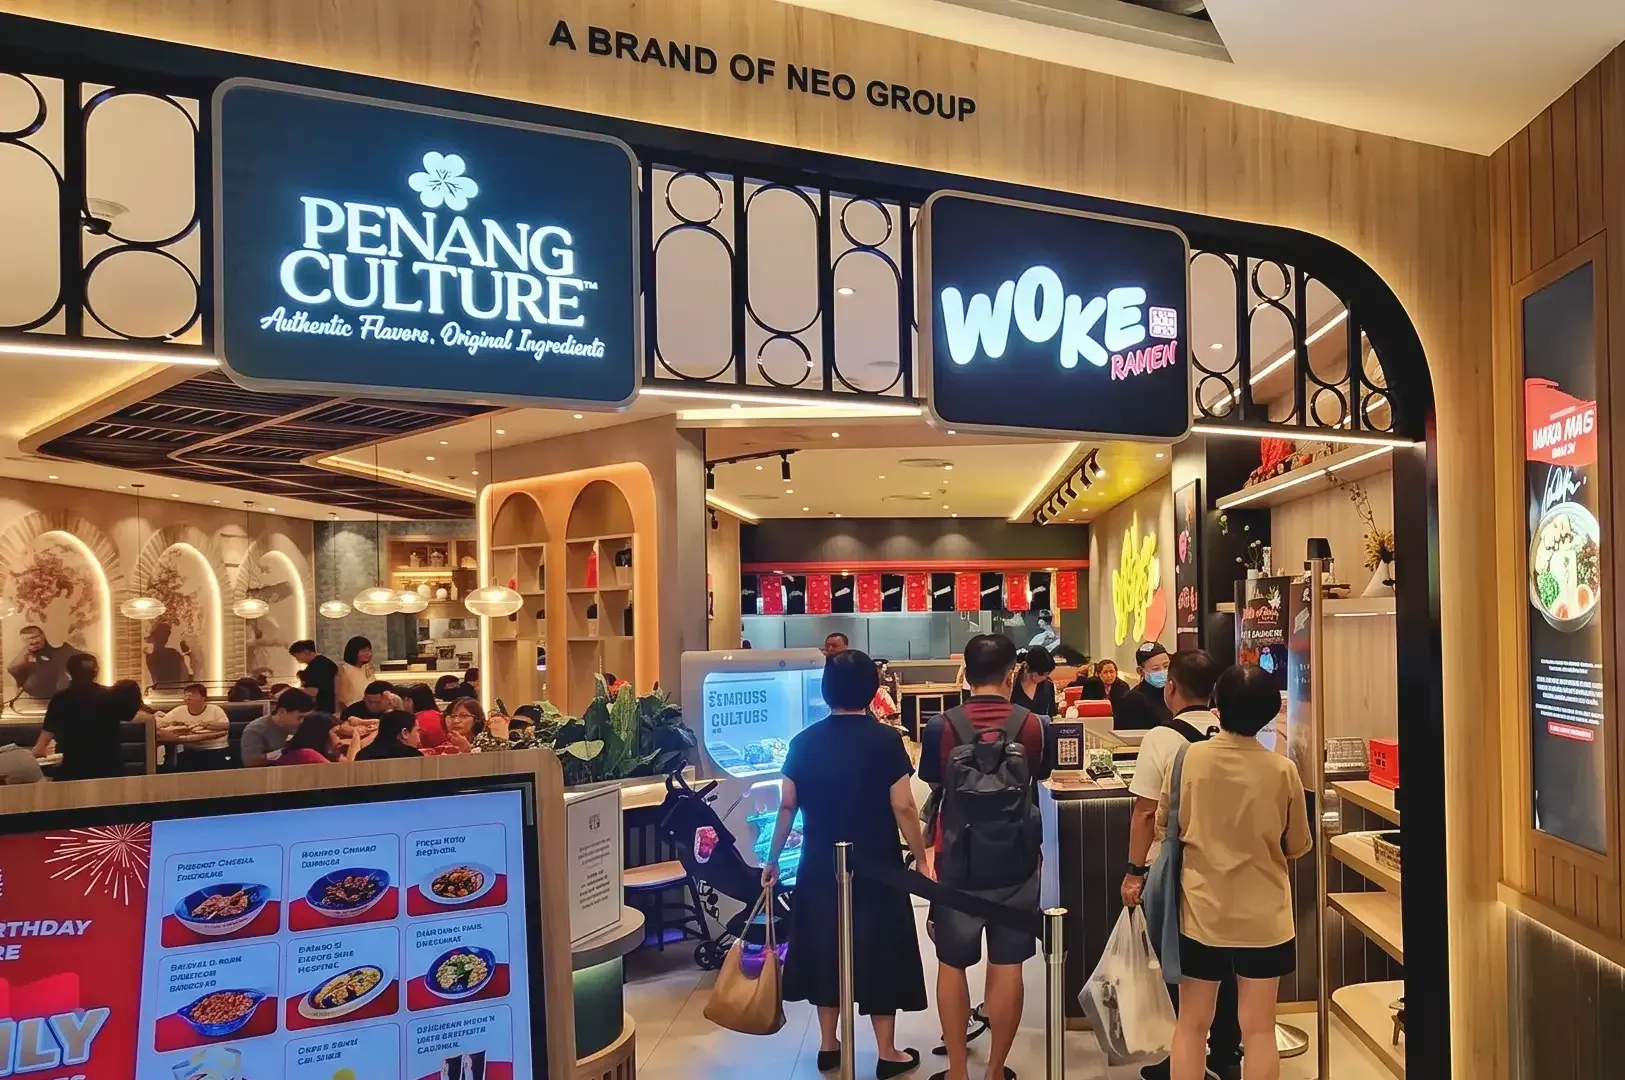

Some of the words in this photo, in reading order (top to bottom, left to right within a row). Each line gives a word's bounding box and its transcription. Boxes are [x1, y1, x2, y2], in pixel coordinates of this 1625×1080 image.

[549, 20, 576, 50] A
[588, 26, 717, 75] BRAND
[729, 54, 776, 85] OF
[787, 64, 856, 98] NEO
[866, 80, 976, 122] GROUP
[299, 196, 575, 276] PENANG
[260, 306, 353, 337] Authentic
[359, 315, 435, 345] Flavors.
[440, 321, 514, 355] Original
[941, 265, 1146, 369] WOKE
[1111, 340, 1178, 381] RAMEN
